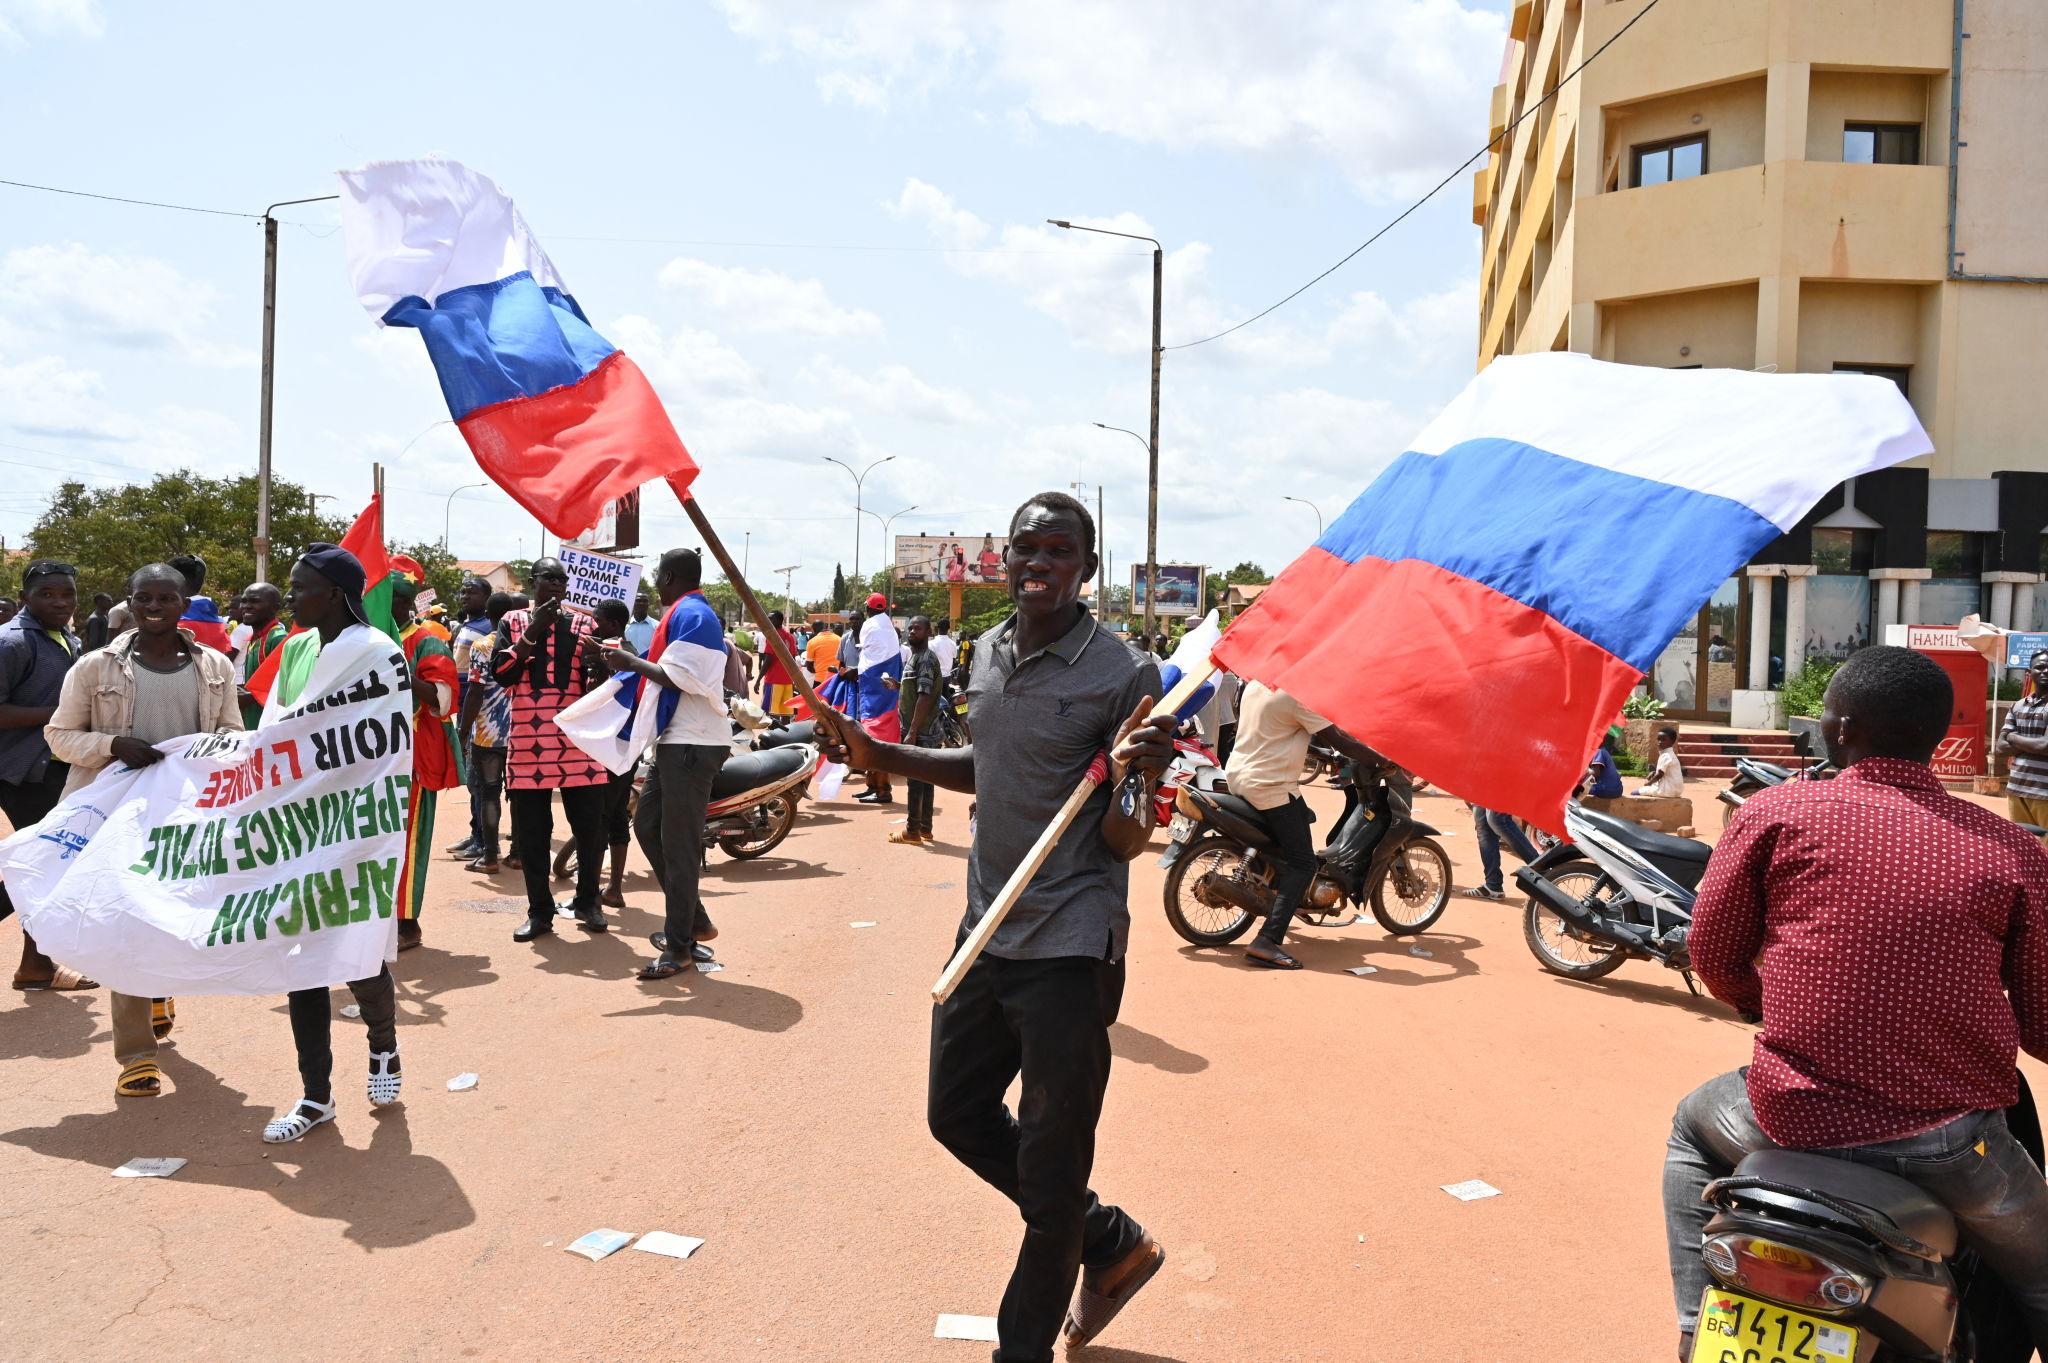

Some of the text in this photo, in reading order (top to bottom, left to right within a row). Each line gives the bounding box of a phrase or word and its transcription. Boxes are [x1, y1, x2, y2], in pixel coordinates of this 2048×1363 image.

[560, 550, 632, 577] LE PEUPLE
[567, 564, 620, 585] NOMME
[564, 591, 602, 608] ARÉC
[576, 577, 627, 600] TRAORE
[310, 711, 411, 771] VOIR
[1929, 763, 1976, 775] AMILTON
[206, 857, 398, 947] AFRICAIN
[1732, 1302, 1815, 1360] 1412
